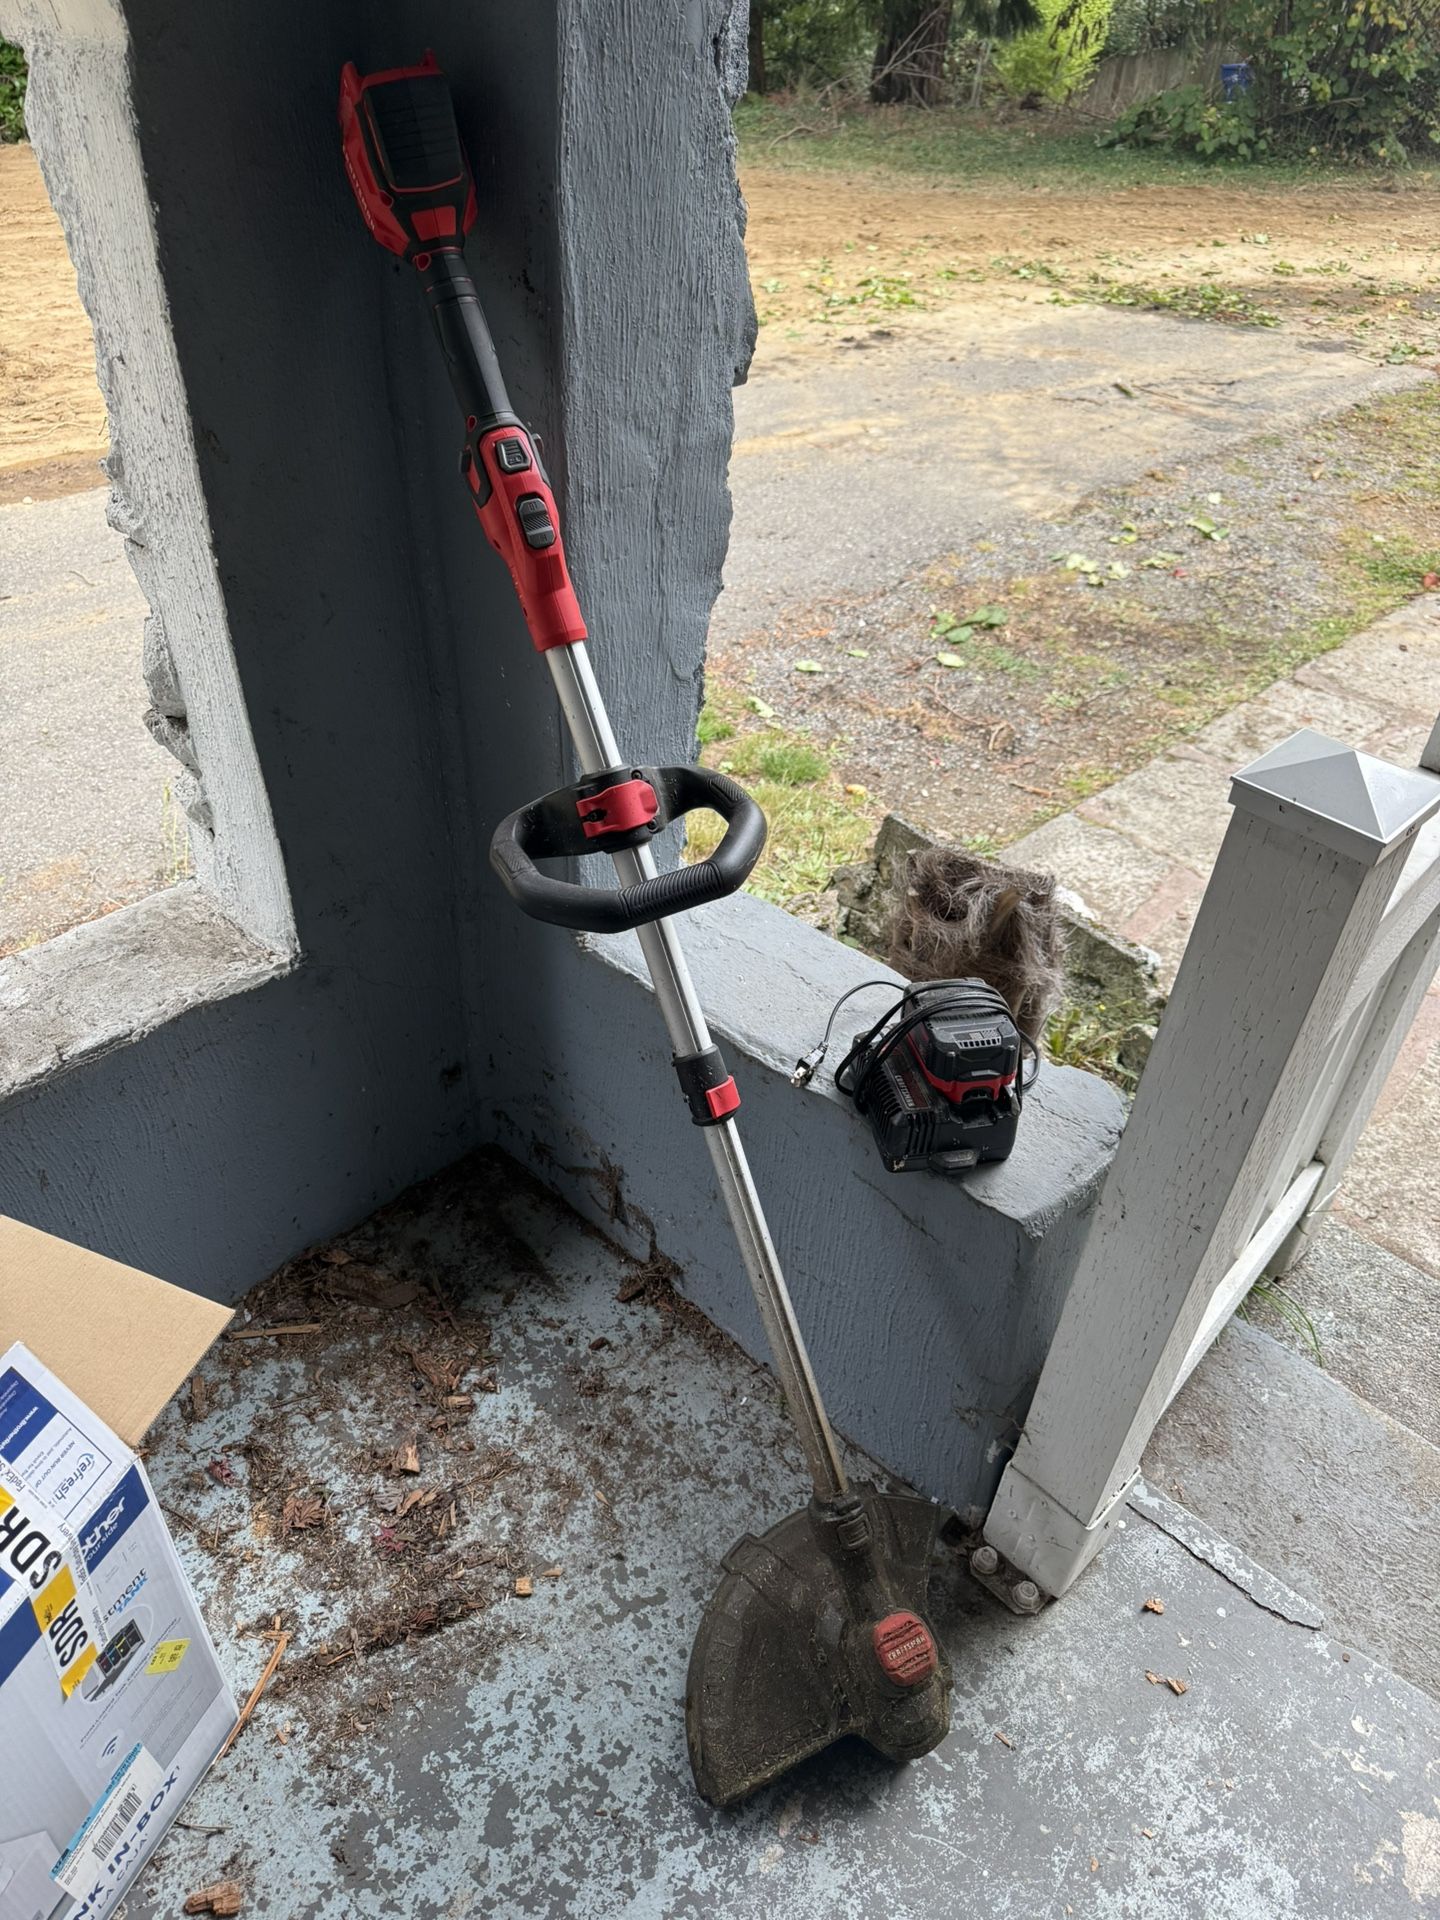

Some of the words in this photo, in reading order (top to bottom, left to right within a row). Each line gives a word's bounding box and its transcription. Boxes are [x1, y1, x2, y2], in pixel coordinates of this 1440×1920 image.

[55, 1456, 92, 1501] refresh
[0, 1506, 62, 1589] SDR
[101, 1522, 118, 1544] side
[116, 1576, 148, 1614] TANK
[49, 1598, 88, 1668] SDR
[888, 1635, 926, 1661] CRAFTSMAN
[98, 1887, 114, 1910] LA
[116, 1838, 147, 1882] CAJA
